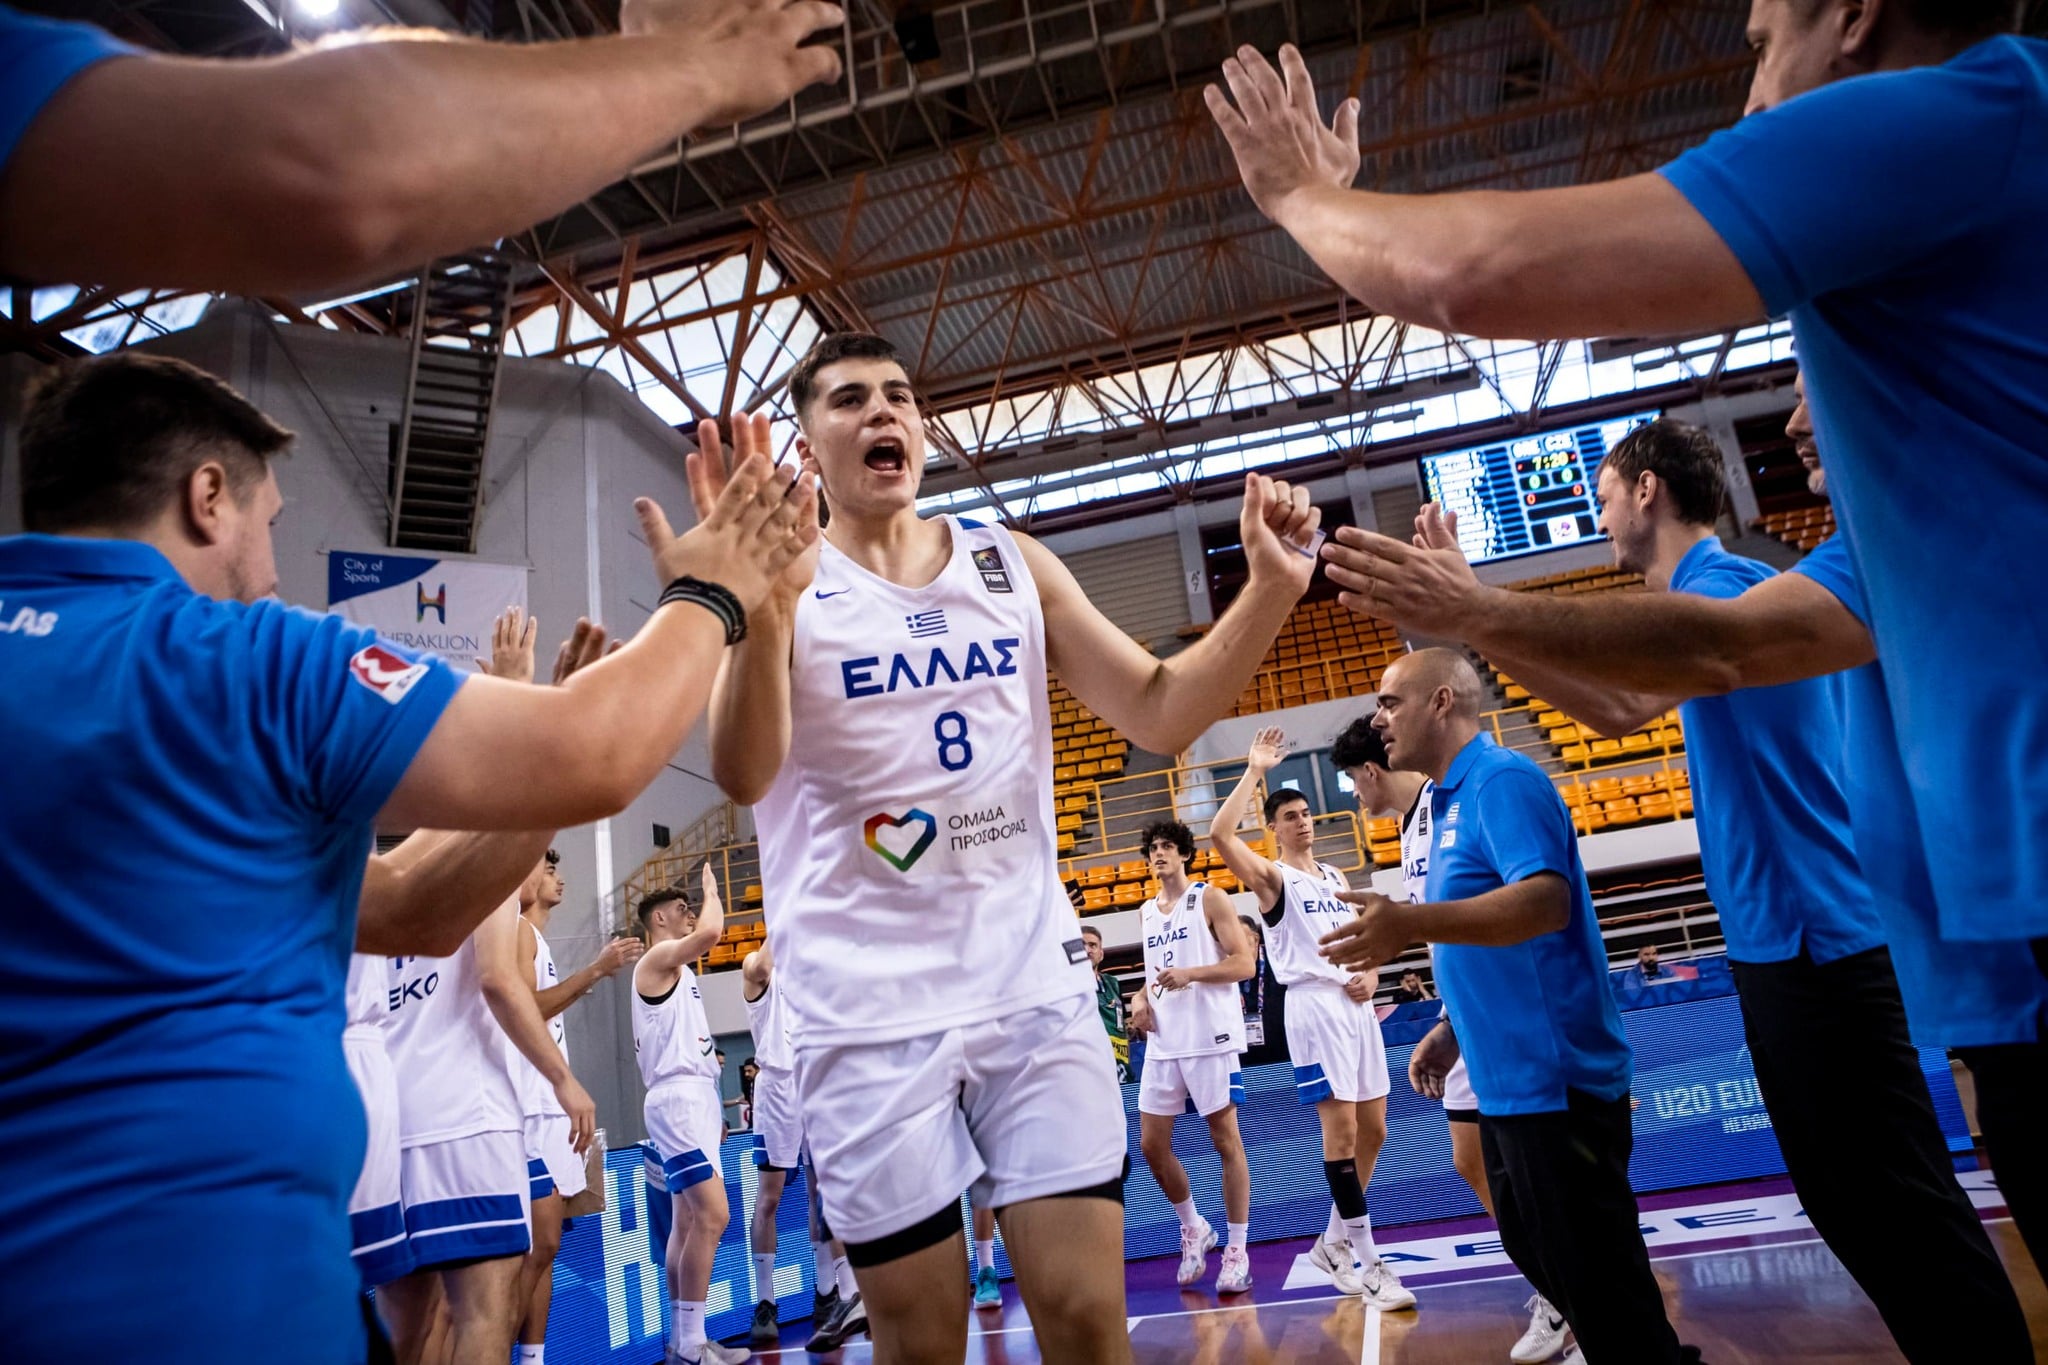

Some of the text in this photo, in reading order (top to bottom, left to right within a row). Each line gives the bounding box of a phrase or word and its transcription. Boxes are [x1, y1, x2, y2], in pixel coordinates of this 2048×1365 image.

[343, 557, 383, 572] City of
[343, 569, 380, 584] Sports
[984, 573, 1005, 582] FIBA
[841, 637, 1020, 699] ΕΛΛΑΣ
[934, 710, 973, 772] 8
[948, 805, 1006, 830] ΟΜΑΔΑ
[951, 818, 1028, 851] ΠΡΟΣΦΟΡΑΣ
[1147, 927, 1188, 948] ΕΛΛΑΣ
[1163, 951, 1173, 968] 12
[388, 971, 439, 1012] EKO
[1653, 1083, 1713, 1119] U20
